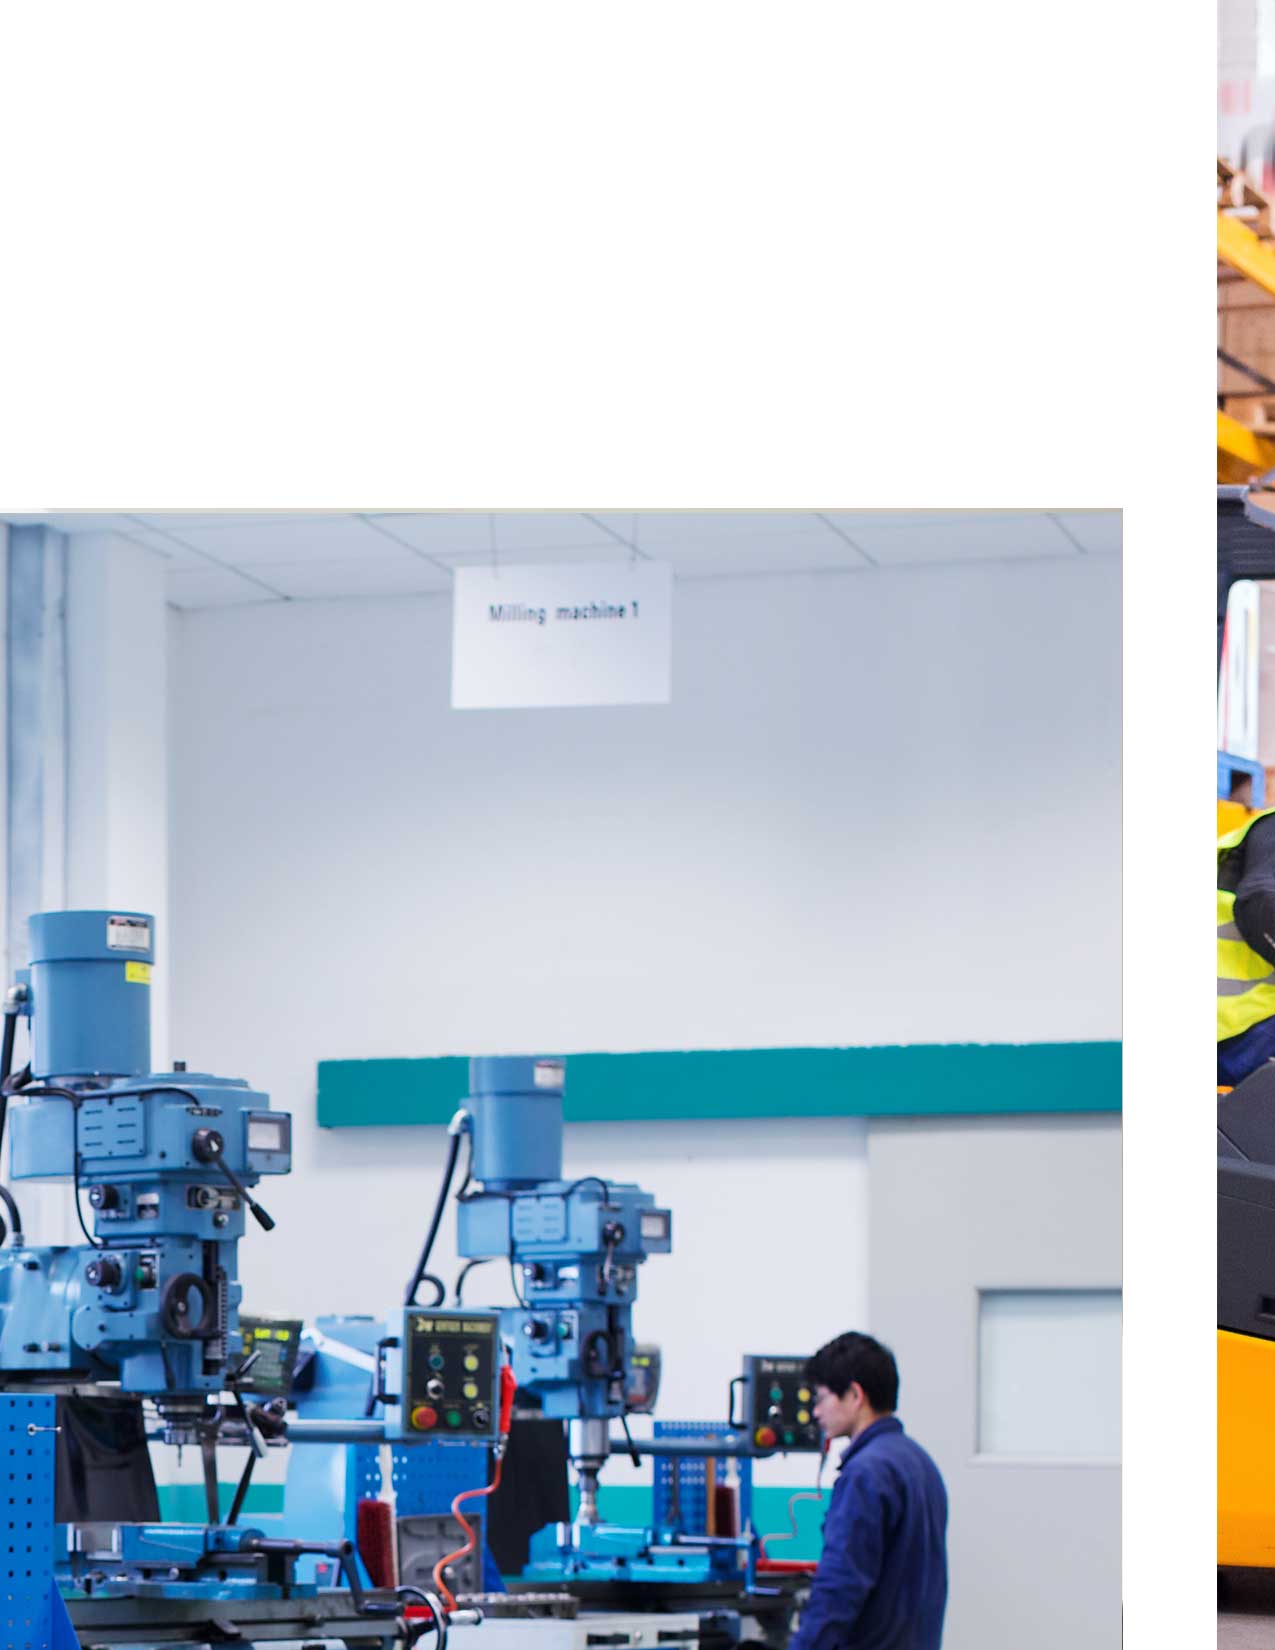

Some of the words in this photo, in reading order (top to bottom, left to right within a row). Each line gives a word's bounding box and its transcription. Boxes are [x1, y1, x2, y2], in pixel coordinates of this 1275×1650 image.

[489, 603, 546, 625] Milling
[556, 601, 626, 620] machine
[632, 600, 639, 618] 1
